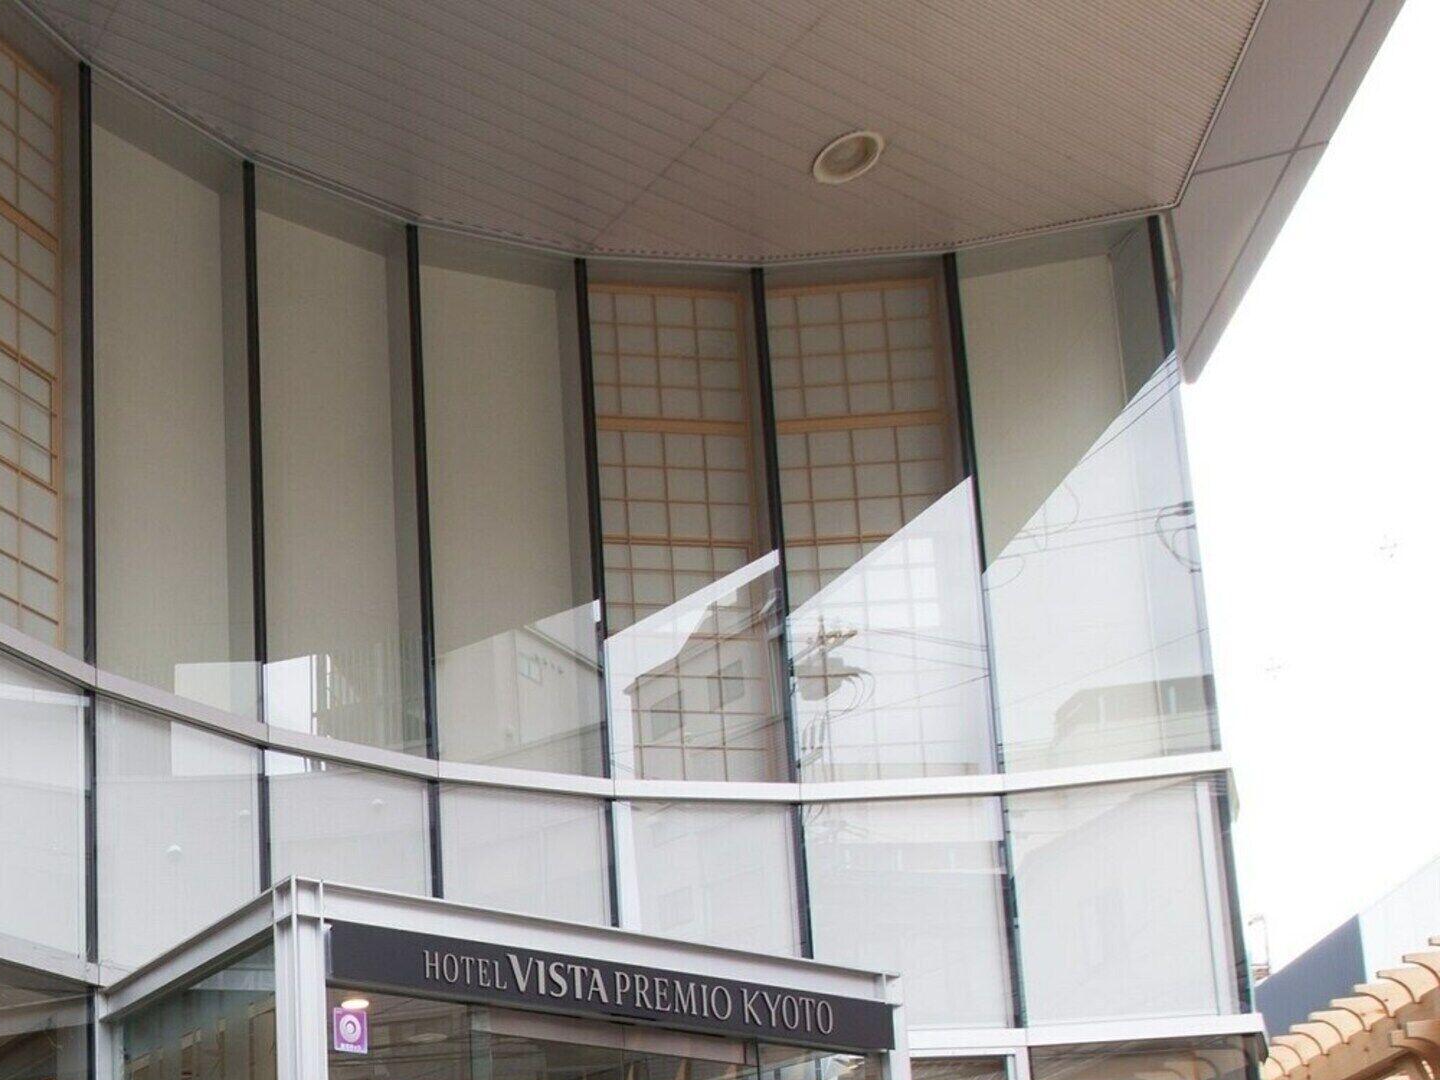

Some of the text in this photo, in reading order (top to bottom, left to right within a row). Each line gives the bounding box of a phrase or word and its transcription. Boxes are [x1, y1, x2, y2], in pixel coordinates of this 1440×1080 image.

[423, 950, 835, 1036] HOTEL VISTA PREMIO KYOTO
